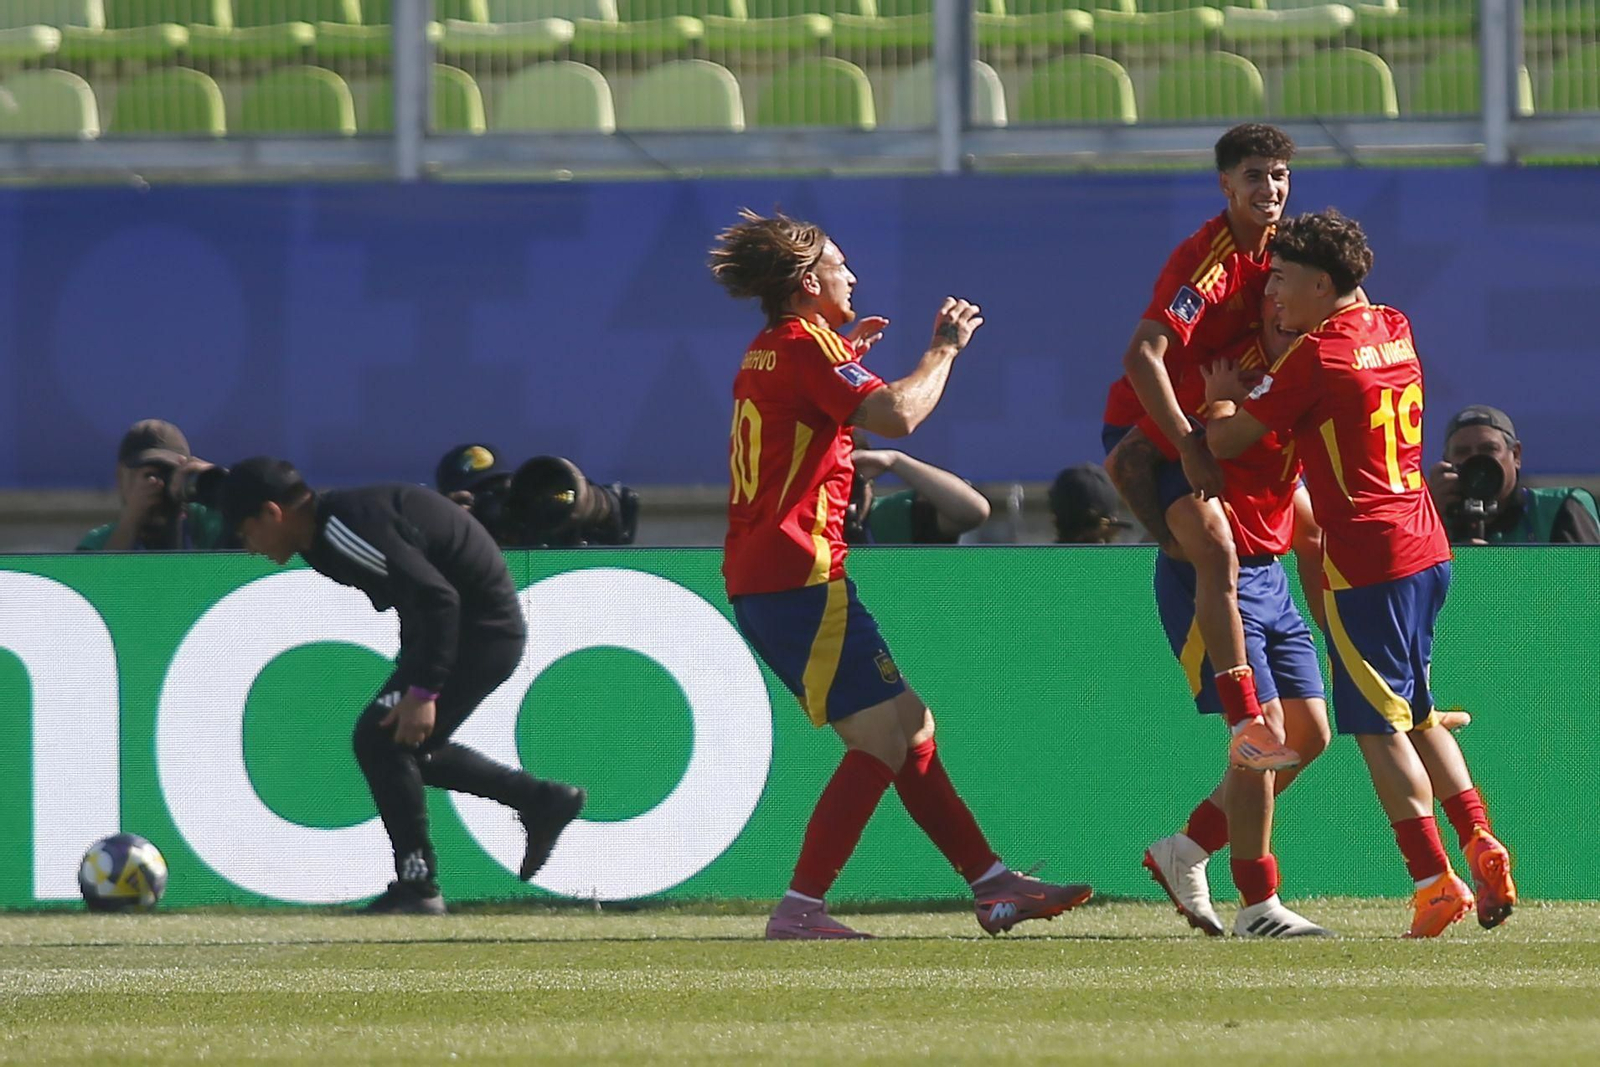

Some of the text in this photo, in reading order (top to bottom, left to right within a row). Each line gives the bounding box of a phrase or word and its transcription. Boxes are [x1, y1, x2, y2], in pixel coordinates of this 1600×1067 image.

[1351, 345, 1382, 371] JAN
[730, 398, 762, 505] 10
[1370, 382, 1423, 494] 19
[0, 568, 774, 905] co
